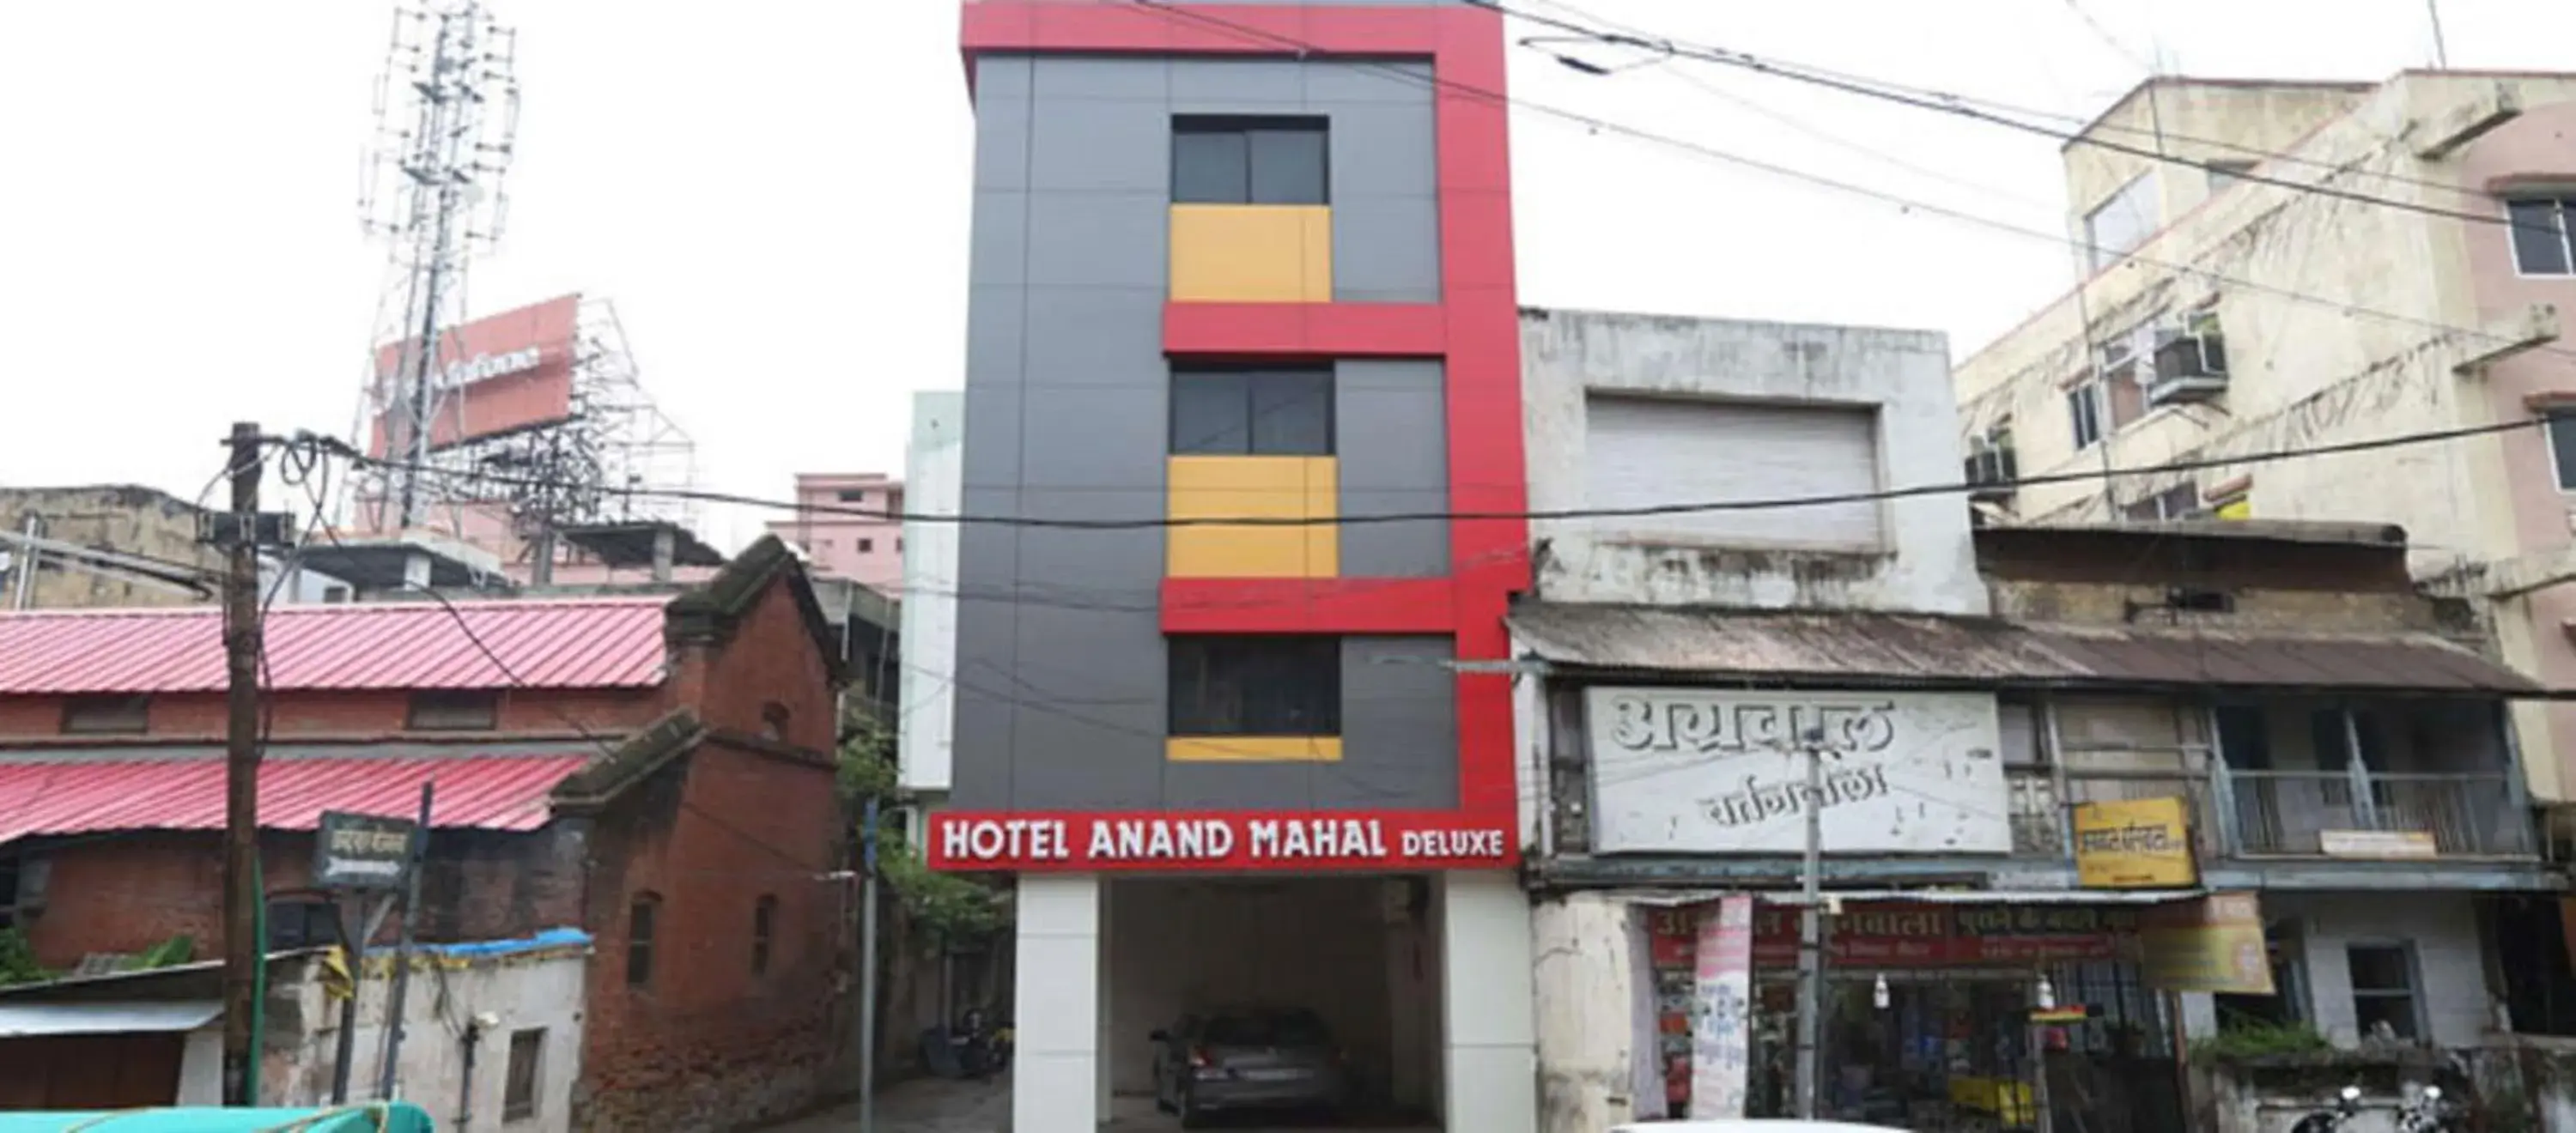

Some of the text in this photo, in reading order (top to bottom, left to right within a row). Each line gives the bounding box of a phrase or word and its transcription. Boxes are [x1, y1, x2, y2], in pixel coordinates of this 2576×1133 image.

[941, 819, 1504, 859] HOTEL ANAND MAHAL DELUXE
